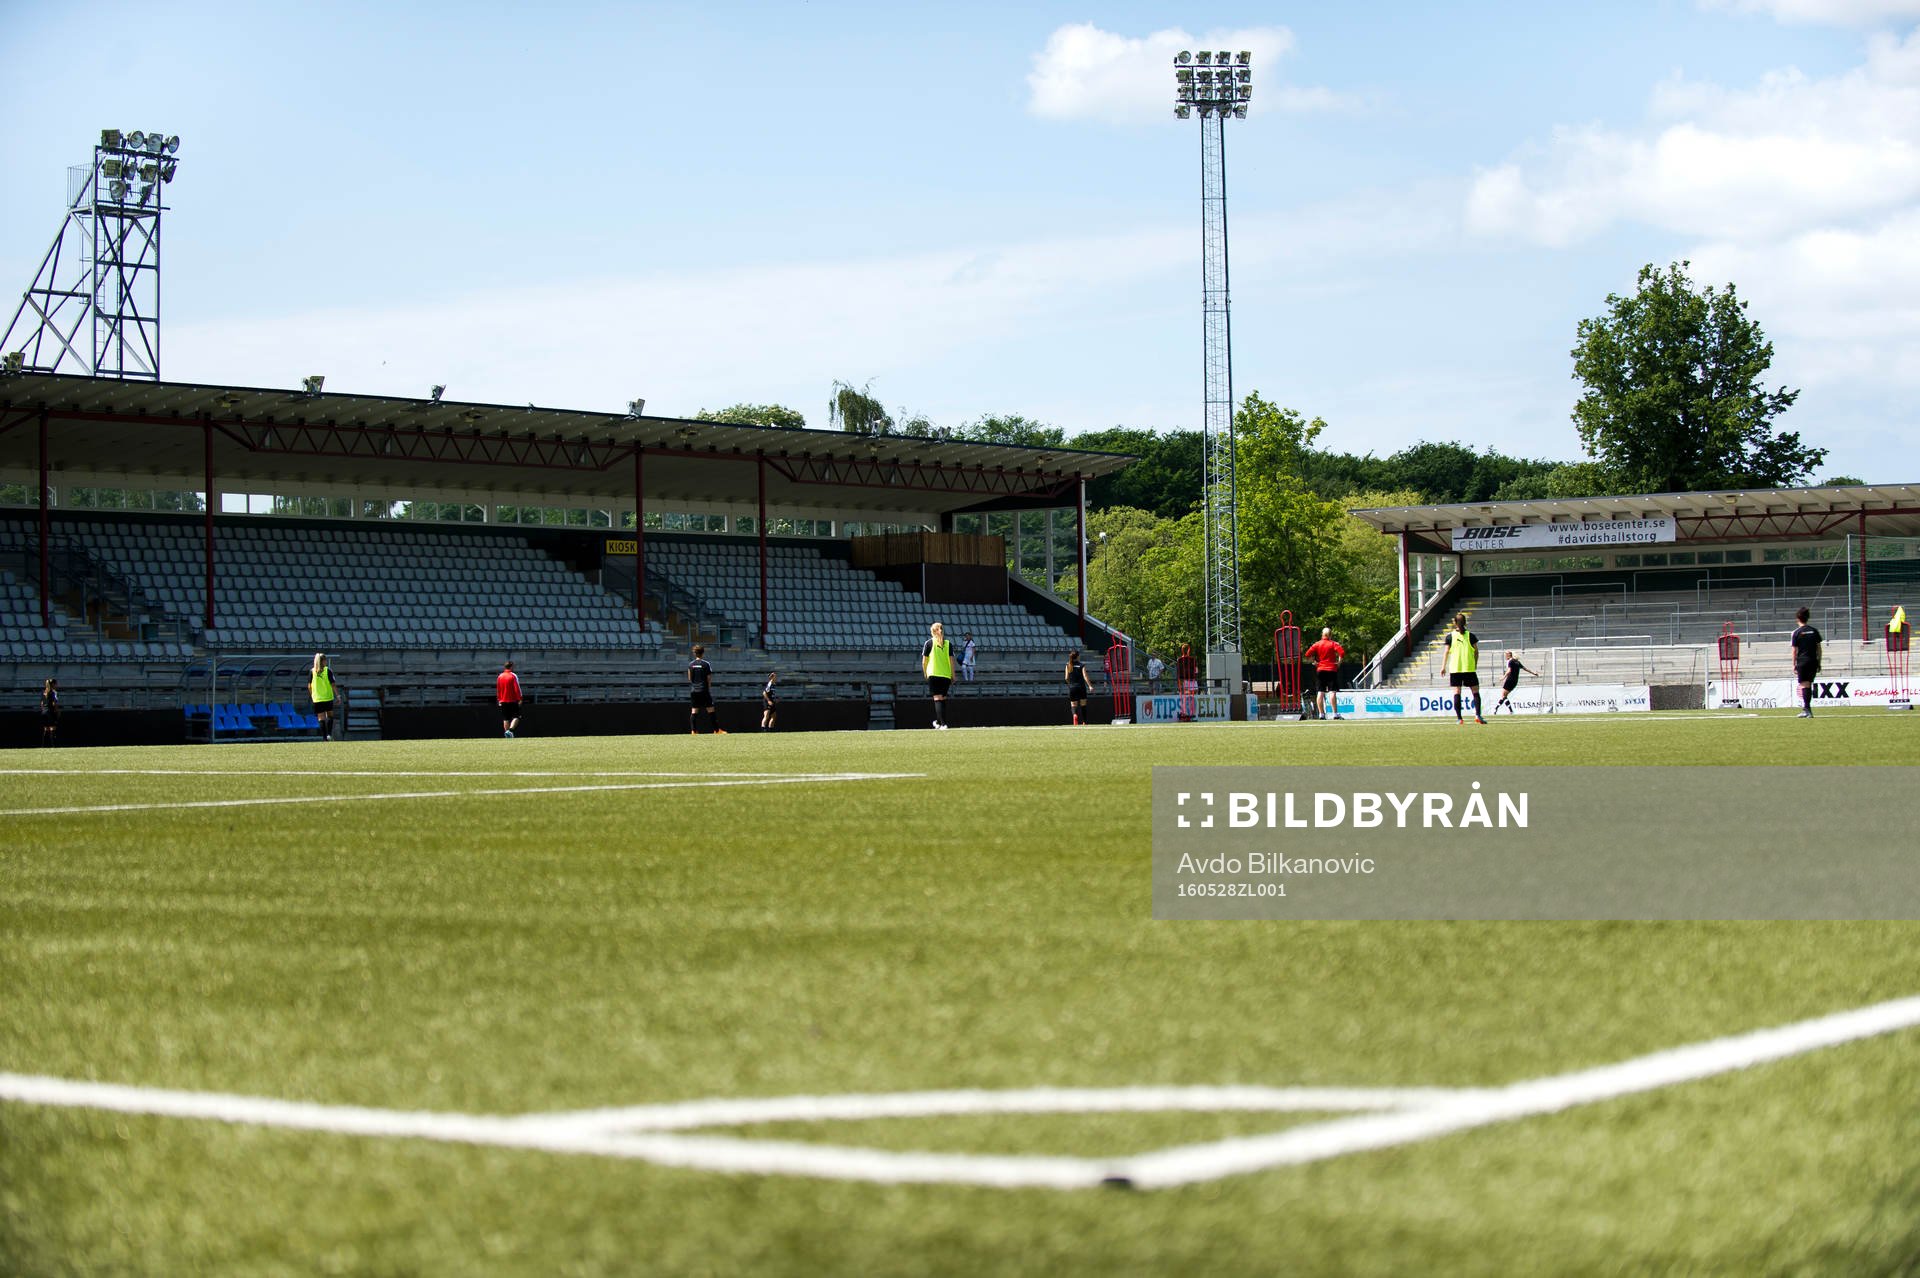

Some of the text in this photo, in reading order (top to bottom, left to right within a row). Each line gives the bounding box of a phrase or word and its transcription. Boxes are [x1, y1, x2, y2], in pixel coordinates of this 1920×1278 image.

[1455, 525, 1530, 539] BOSE
[1548, 519, 1665, 532] www.bosecenter.se
[1558, 531, 1657, 544] #davidshallstorg
[609, 542, 637, 553] KIOSK
[1460, 540, 1504, 550] CENTER
[1365, 696, 1402, 704] SANDVIK
[1198, 697, 1226, 718] ELIT
